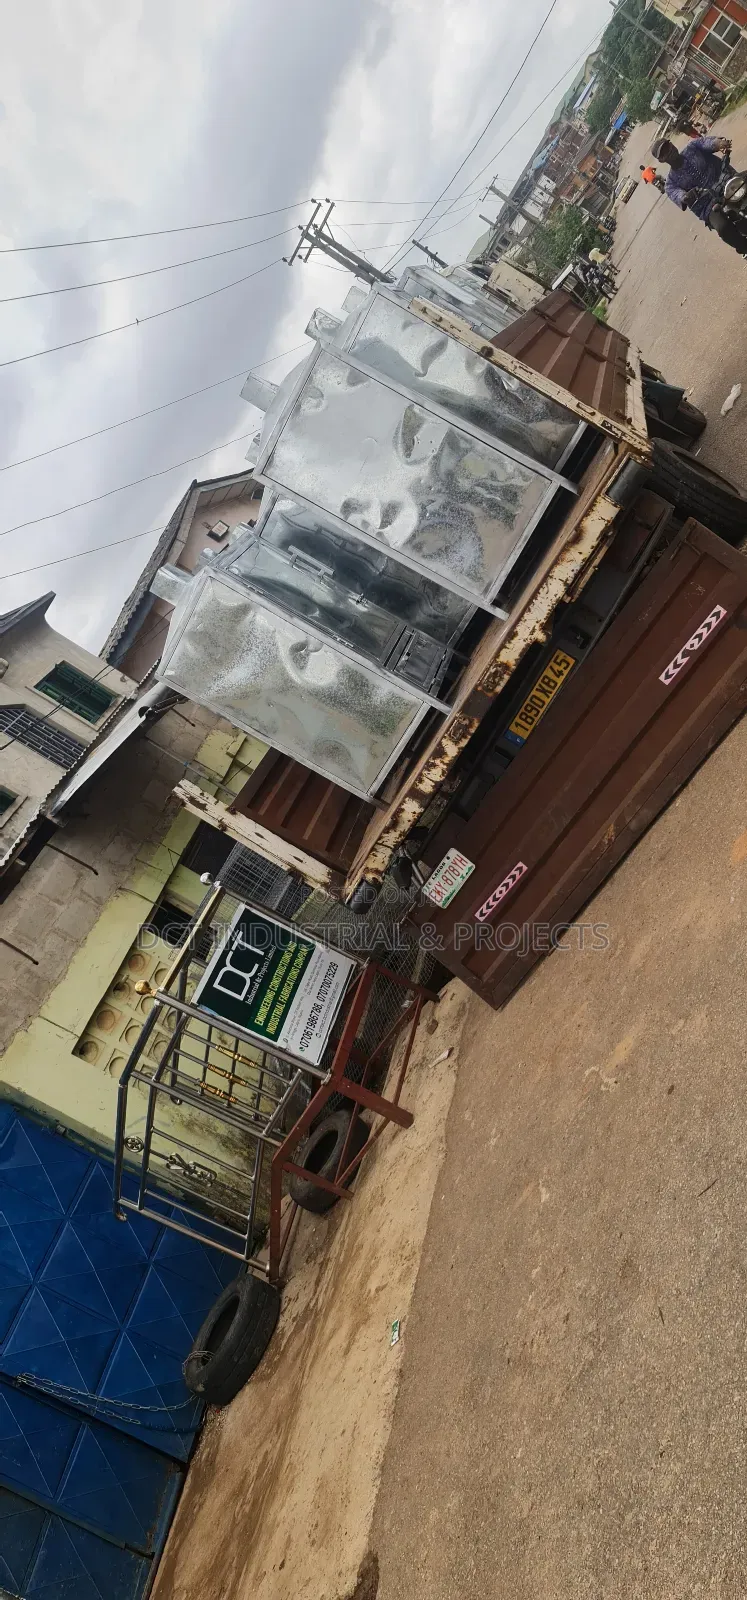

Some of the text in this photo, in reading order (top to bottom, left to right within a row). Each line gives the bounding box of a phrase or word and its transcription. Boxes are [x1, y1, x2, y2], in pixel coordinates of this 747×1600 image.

[514, 654, 571, 732] 1890 XB 45
[431, 861, 446, 880] LAGOS
[213, 930, 265, 1001] DCT
[254, 988, 276, 1027] ENGINEERING
[269, 949, 293, 991] CONSTRUCTIONS
[265, 1000, 286, 1035] INDUSTRIAL
[281, 966, 301, 1004] FABRICATIONS
[293, 944, 309, 969] COMPANY
